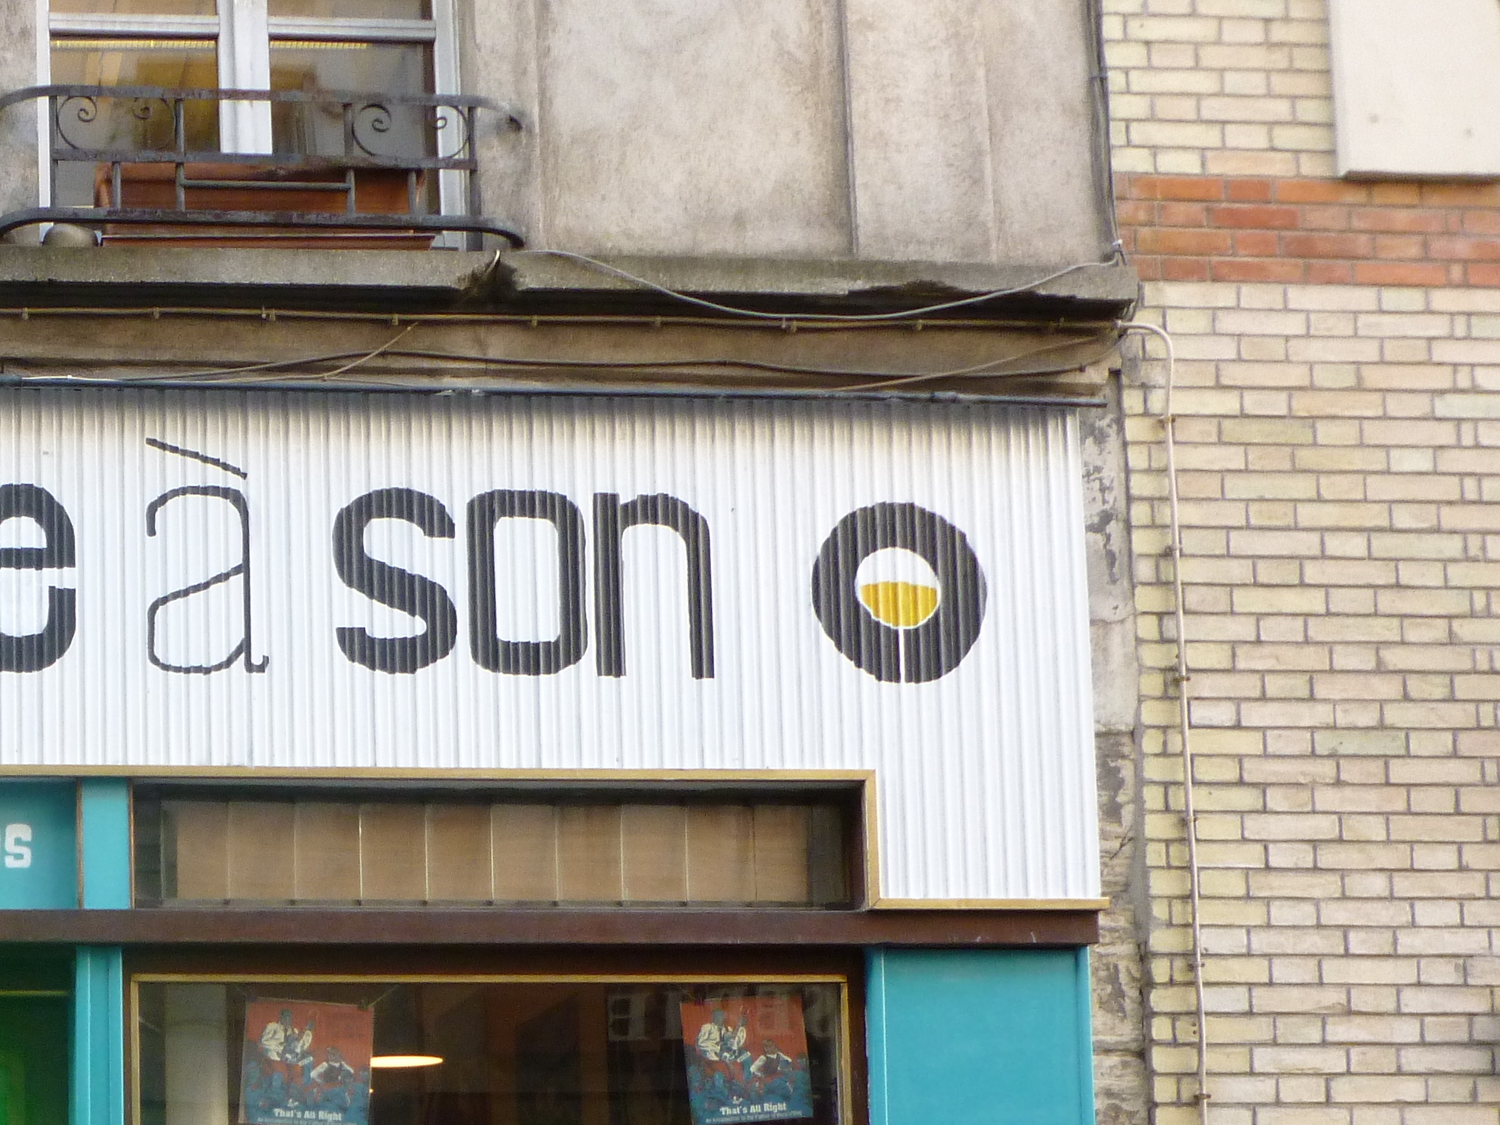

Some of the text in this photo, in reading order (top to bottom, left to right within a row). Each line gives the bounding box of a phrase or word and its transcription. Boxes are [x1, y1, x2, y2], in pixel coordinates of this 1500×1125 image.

[145, 436, 269, 674] à
[332, 486, 715, 679] son
[273, 1108, 342, 1121] That's All Right
[720, 1102, 787, 1117] That's All Right
